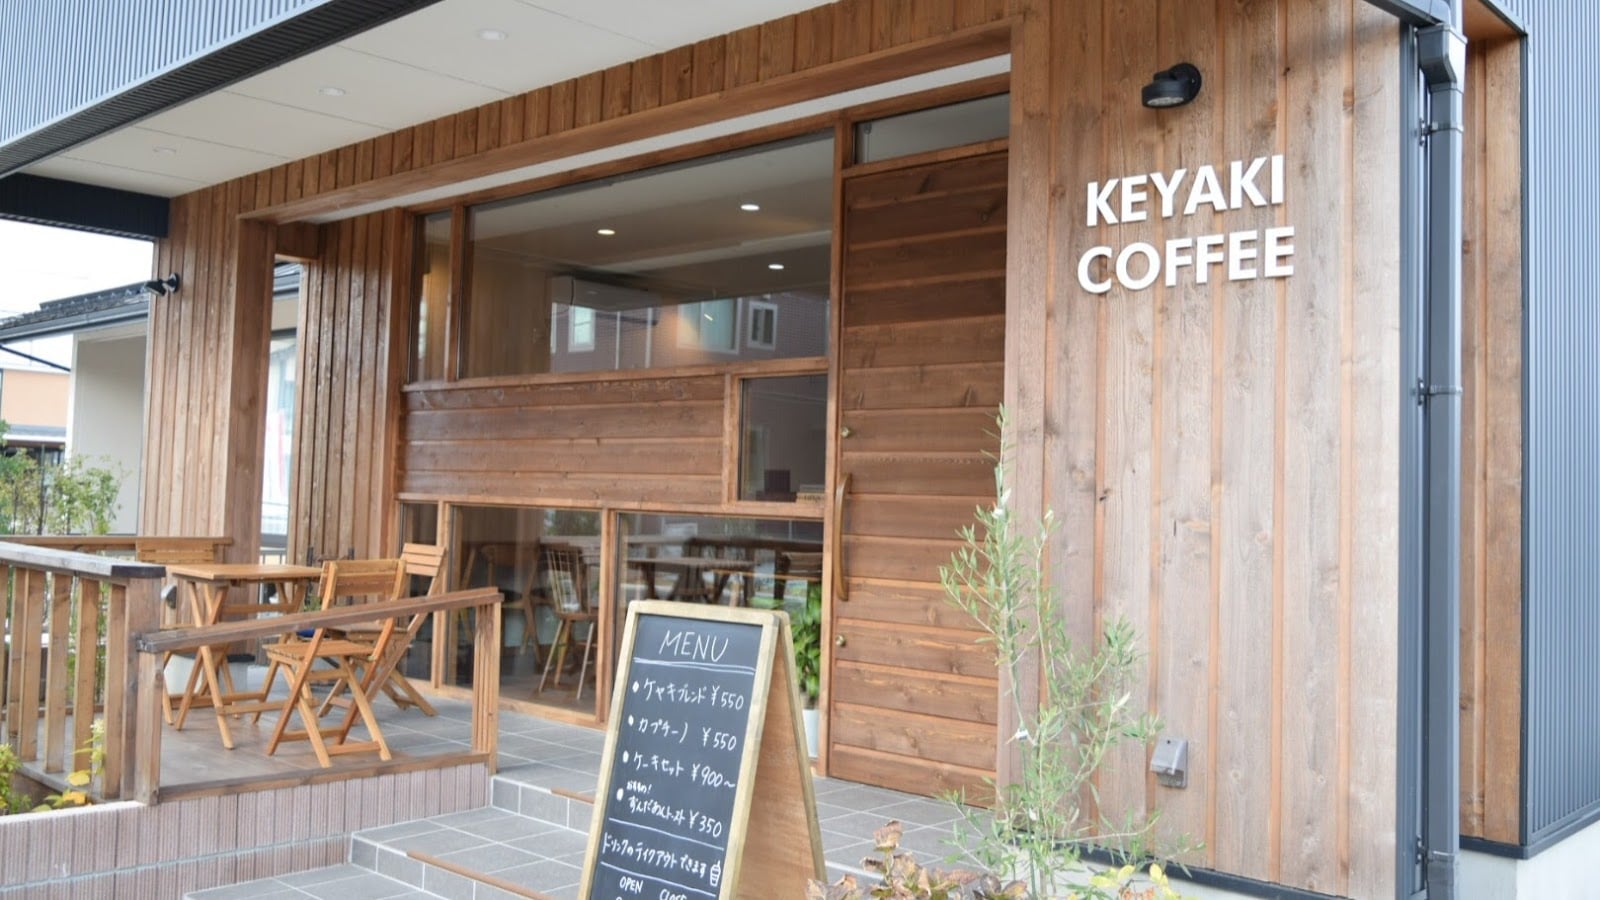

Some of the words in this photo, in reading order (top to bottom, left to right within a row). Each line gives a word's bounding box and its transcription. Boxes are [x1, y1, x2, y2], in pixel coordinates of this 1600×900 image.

[1086, 154, 1285, 227] KEYAKI
[1077, 226, 1296, 294] COFFEE
[658, 629, 729, 663] MENU
[643, 677, 708, 704] ケヤキブレンド
[638, 717, 689, 744] カプチーノ
[633, 751, 685, 777] ケーキセット
[619, 875, 644, 895] OPEN
